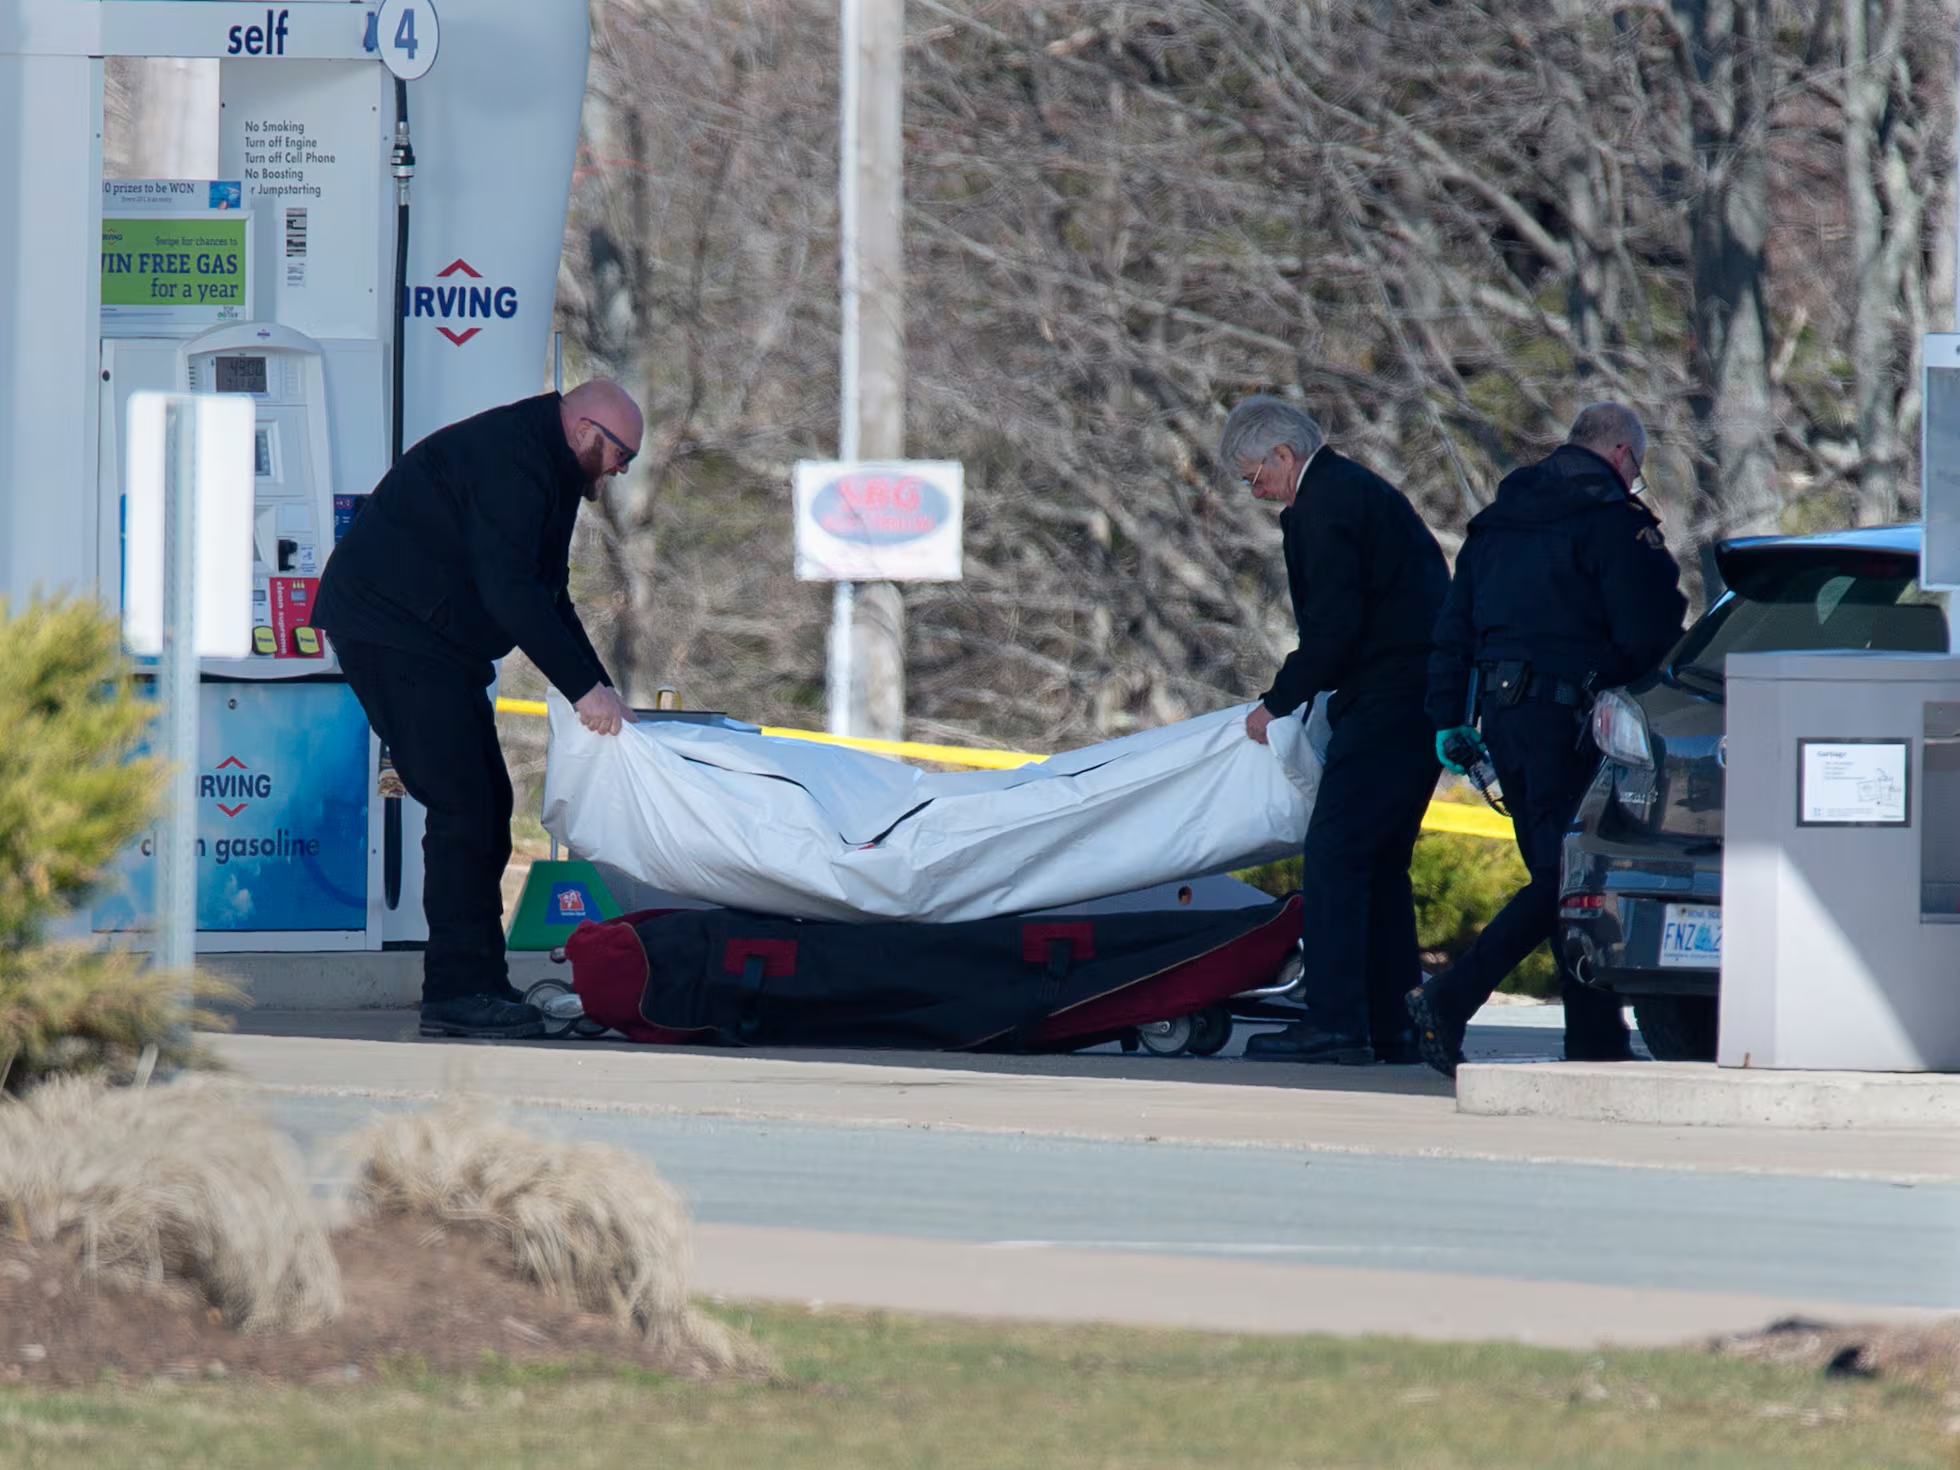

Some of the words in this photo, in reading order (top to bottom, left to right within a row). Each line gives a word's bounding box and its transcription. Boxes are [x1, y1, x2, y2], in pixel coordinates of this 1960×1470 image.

[227, 9, 289, 55] self
[394, 8, 418, 60] 4
[245, 121, 259, 132] No
[262, 120, 305, 135] Smoking
[245, 136, 265, 148] Turn
[268, 135, 282, 148] off
[285, 136, 317, 150] Engine
[245, 152, 265, 163] Turn
[268, 151, 282, 163] off
[285, 151, 302, 163] Cell
[306, 151, 336, 163] Phone
[245, 168, 259, 179] No
[262, 168, 304, 182] Boosting
[113, 182, 142, 196] prizes
[144, 183, 153, 193] to
[156, 182, 167, 193] be
[169, 183, 194, 194] WON
[258, 183, 321, 198] Jumpstarting
[155, 236, 179, 247] Swipe
[181, 236, 193, 246] for
[195, 236, 228, 246] chances
[230, 237, 238, 246] to
[138, 253, 191, 274] FREE
[196, 253, 238, 275] GAS
[151, 277, 177, 298] for
[182, 284, 192, 298] a
[197, 283, 239, 303] year
[404, 286, 518, 318] IRVING
[276, 580, 284, 609] clean
[278, 611, 288, 655] supreme
[140, 830, 206, 857] cln
[215, 828, 320, 865] gasoline
[1664, 922, 1696, 951] FNZ
